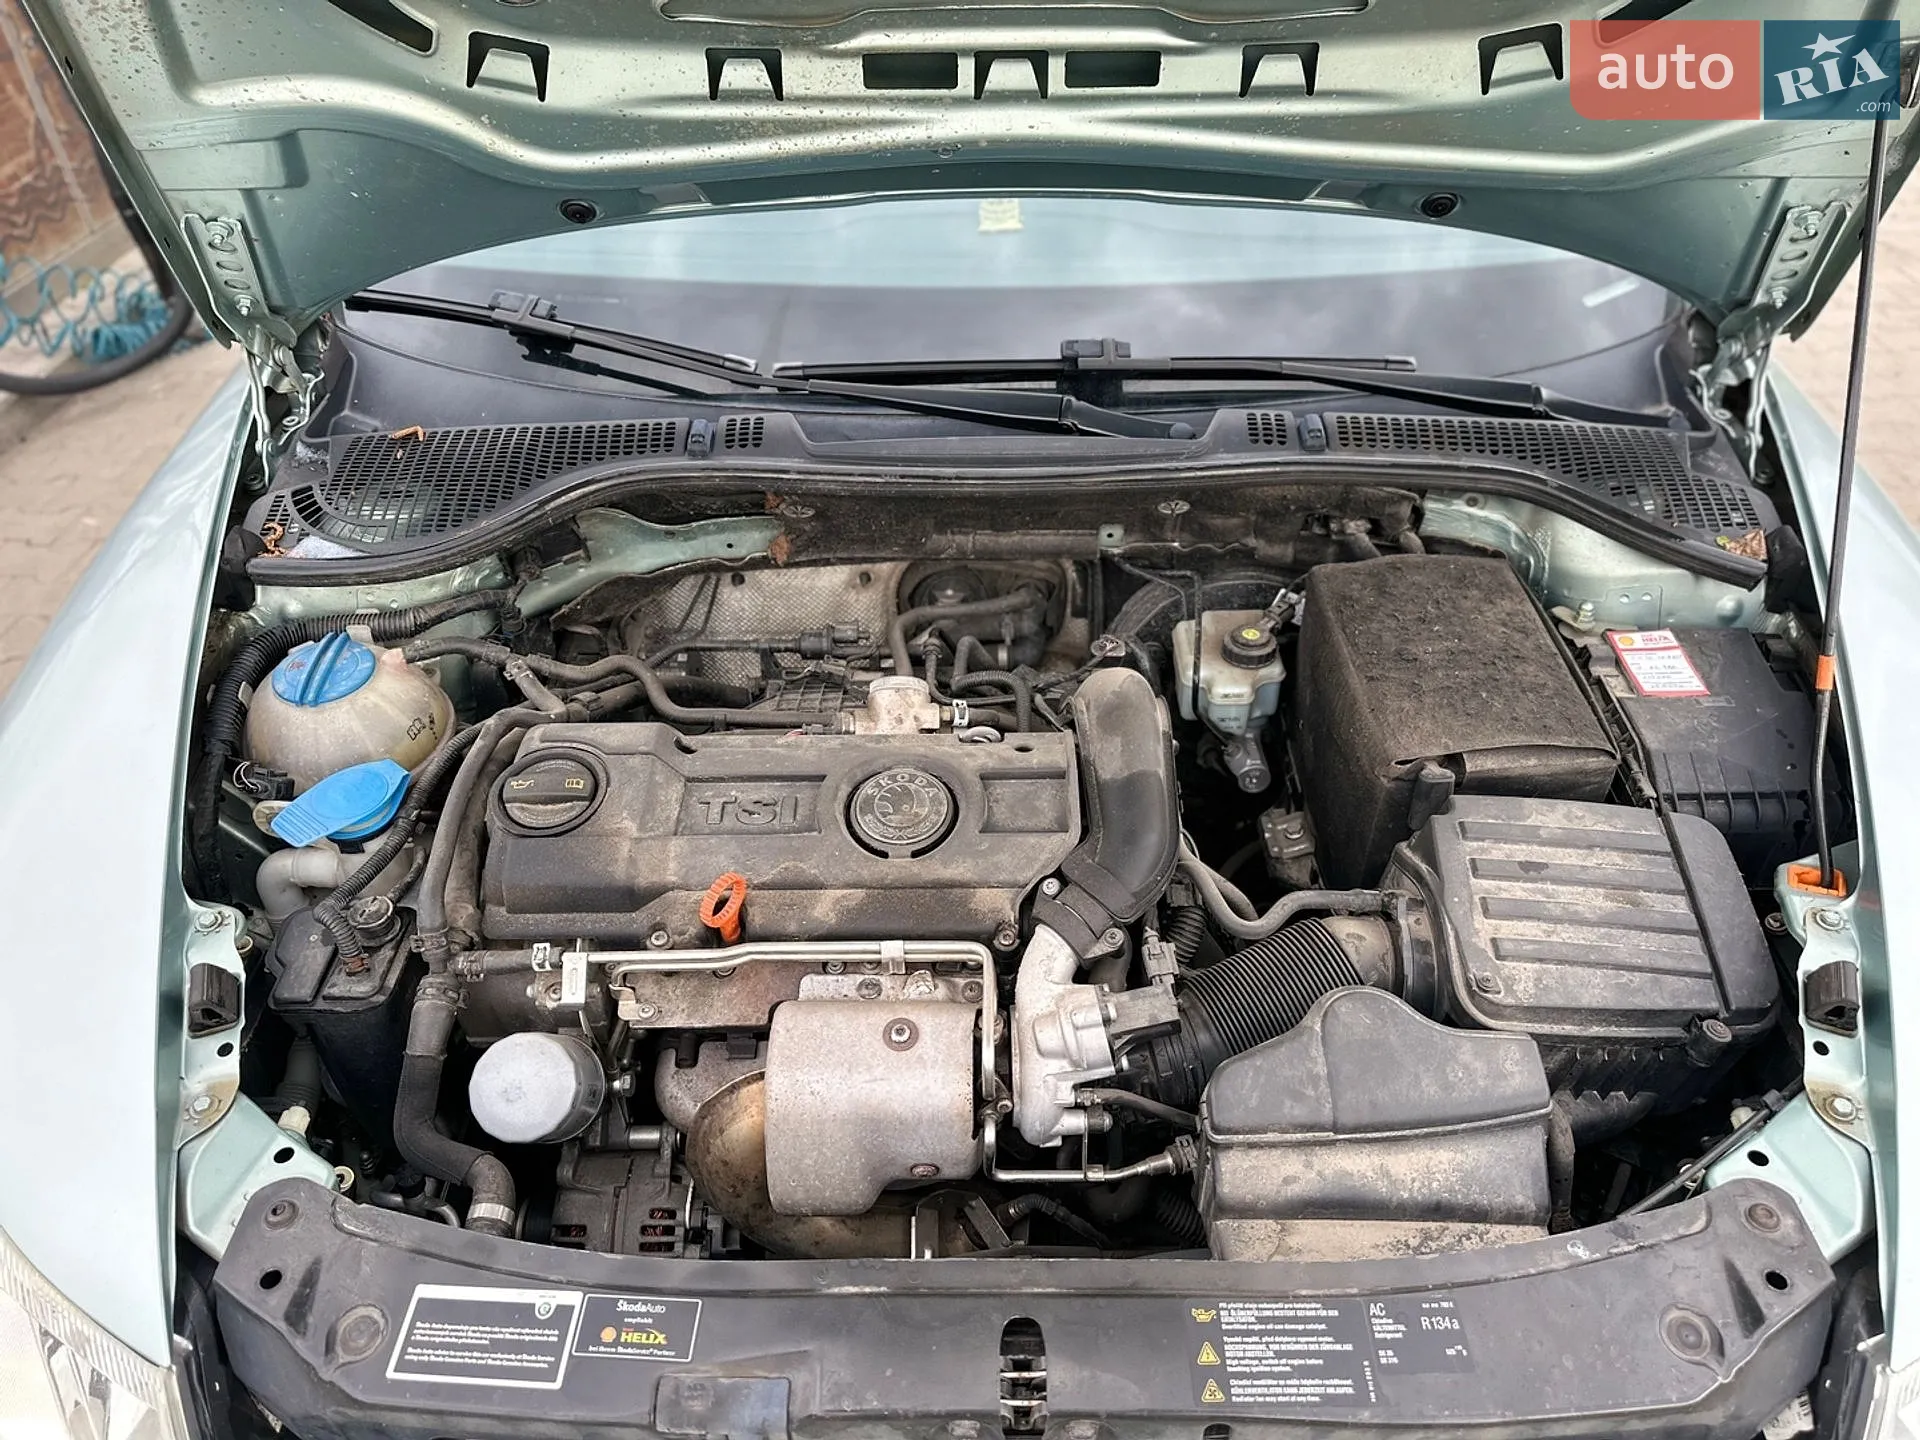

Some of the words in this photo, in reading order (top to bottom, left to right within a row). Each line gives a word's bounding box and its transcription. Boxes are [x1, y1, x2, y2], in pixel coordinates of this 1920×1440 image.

[698, 796, 799, 826] TSI
[1369, 1302, 1386, 1316] AC
[620, 1331, 668, 1345] HELIX
